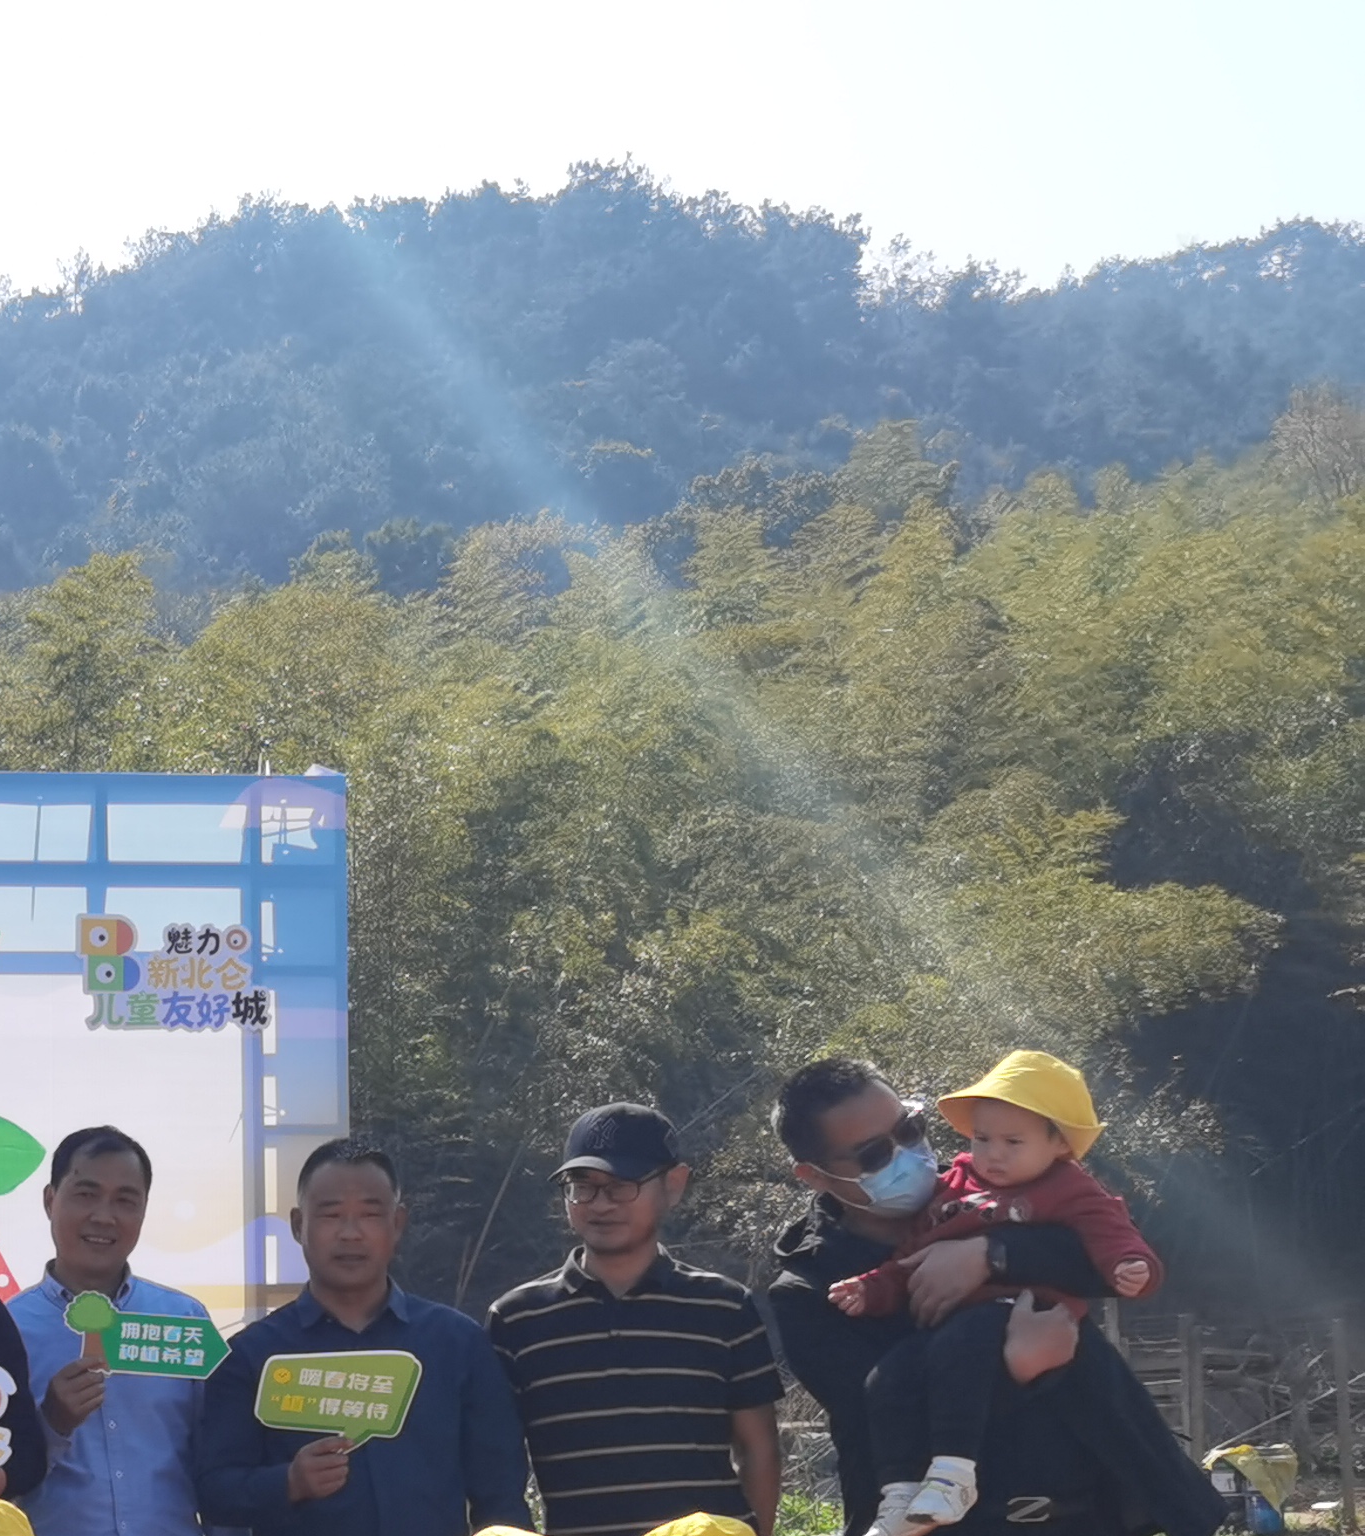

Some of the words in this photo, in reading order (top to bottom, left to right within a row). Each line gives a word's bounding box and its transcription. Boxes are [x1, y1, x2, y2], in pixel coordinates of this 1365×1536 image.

[165, 927, 221, 955] 魅力
[147, 956, 248, 991] 新北仑
[89, 990, 268, 1028] 儿童友好城
[120, 1321, 205, 1345] 拥抱春天
[118, 1343, 206, 1367] 种植希望
[298, 1367, 396, 1395] 暖春将至
